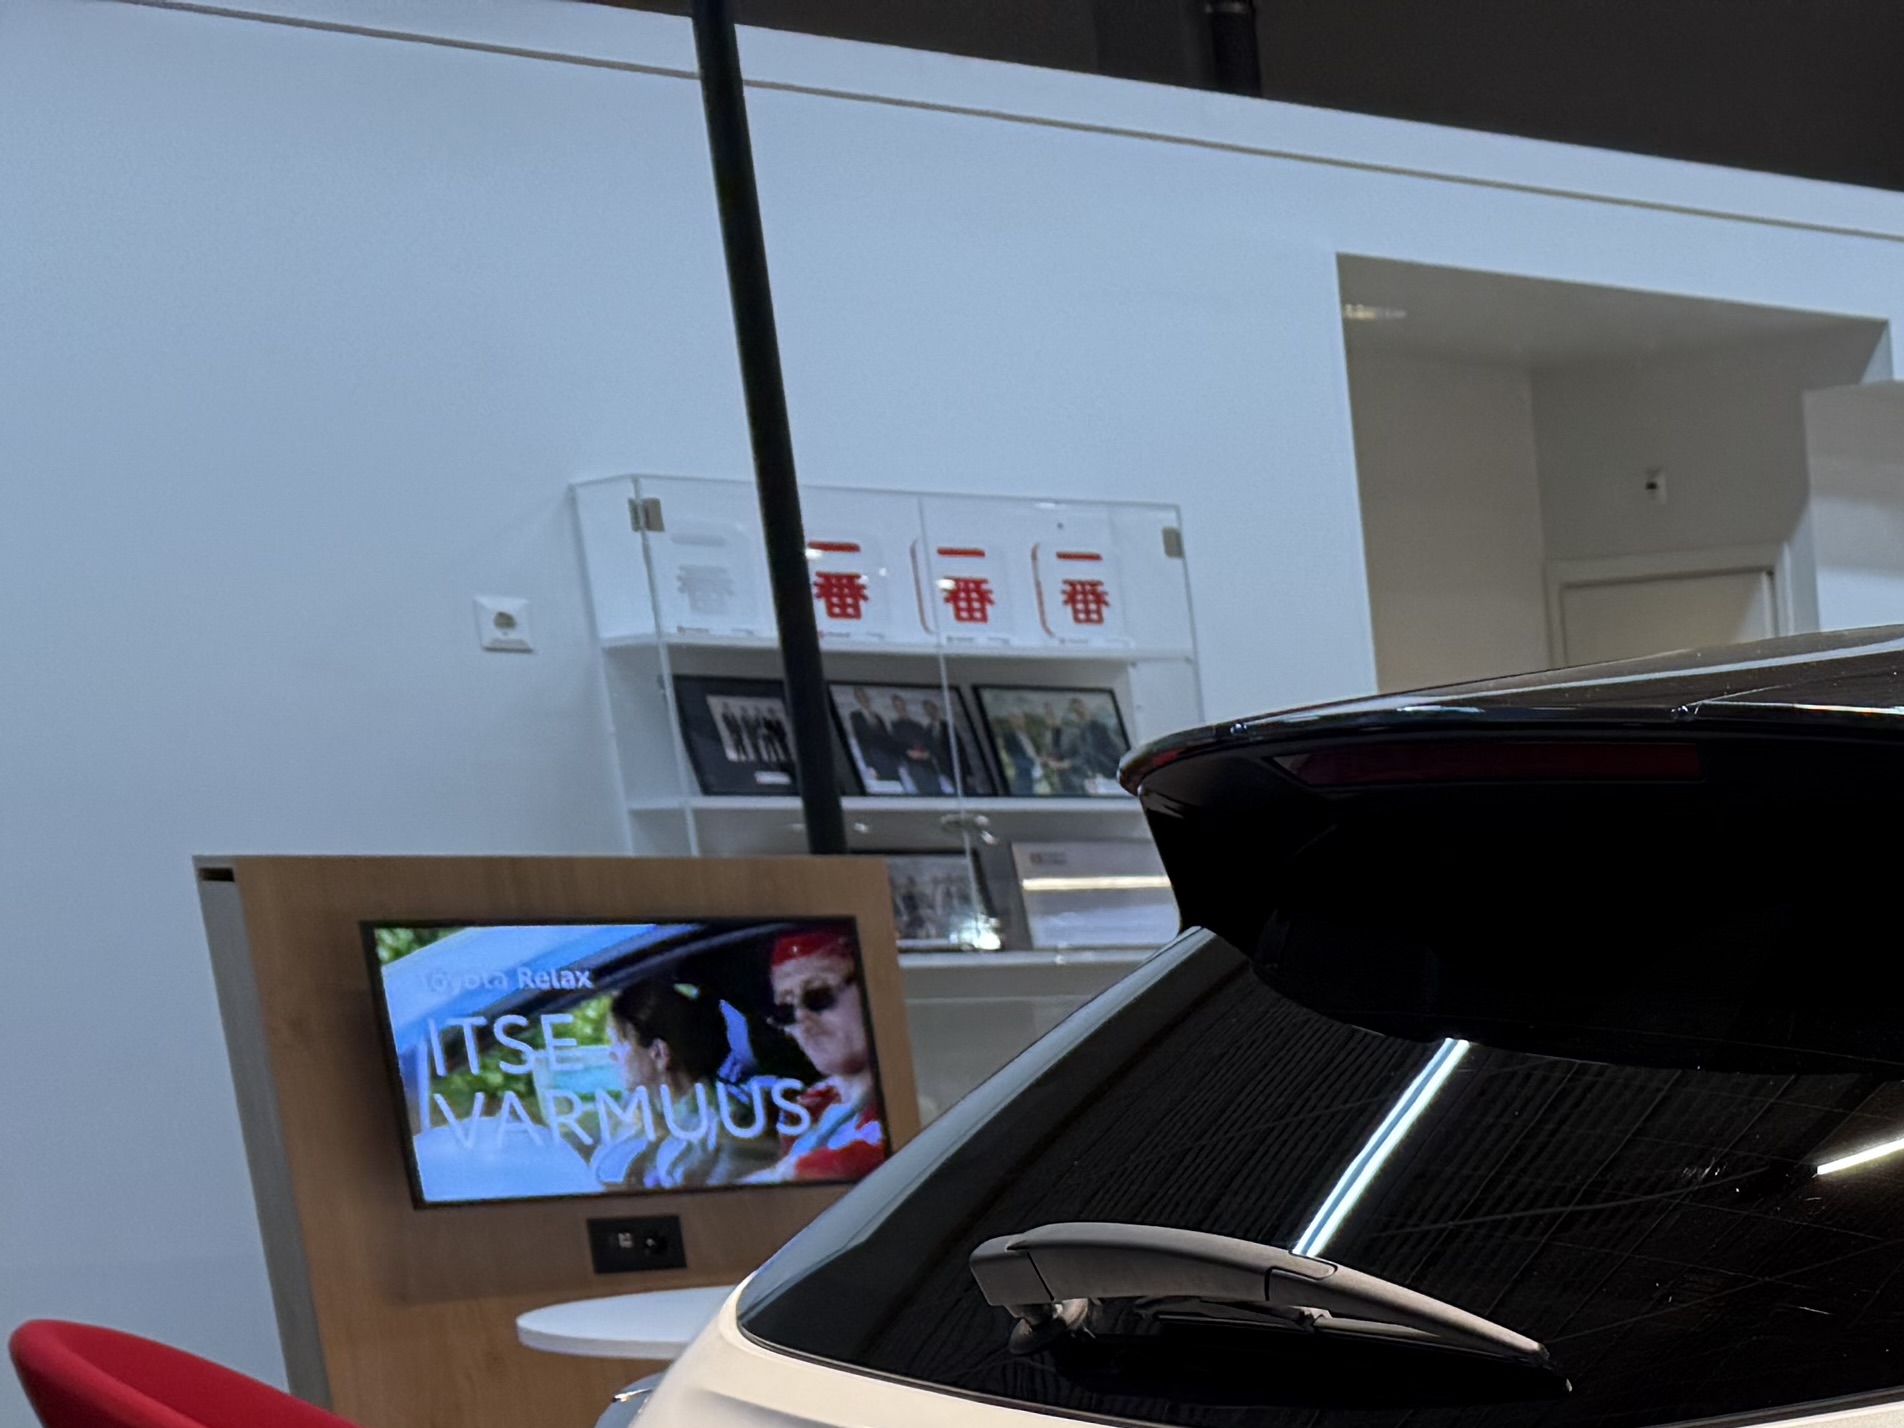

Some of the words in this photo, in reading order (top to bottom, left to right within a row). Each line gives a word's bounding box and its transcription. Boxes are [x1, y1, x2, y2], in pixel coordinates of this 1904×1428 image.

[517, 966, 595, 990] Relax
[428, 1012, 584, 1077] ITSE
[433, 1077, 812, 1150] VARMUUS
